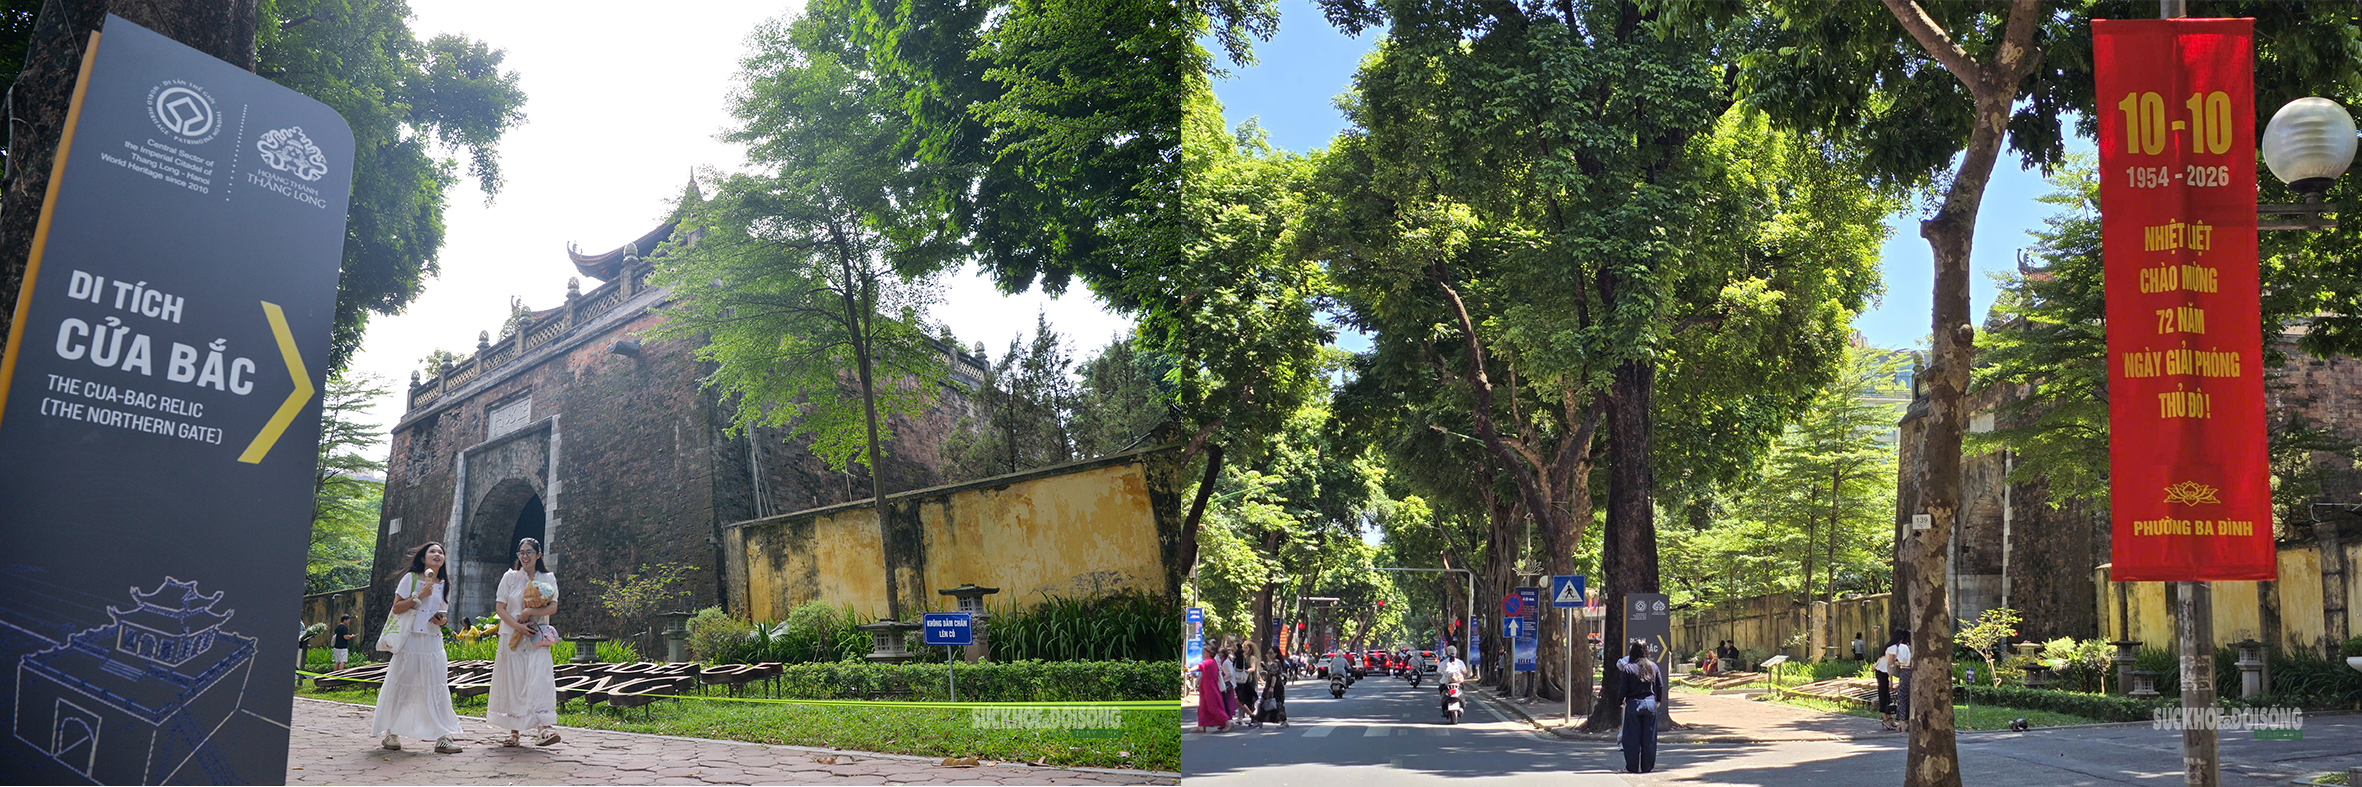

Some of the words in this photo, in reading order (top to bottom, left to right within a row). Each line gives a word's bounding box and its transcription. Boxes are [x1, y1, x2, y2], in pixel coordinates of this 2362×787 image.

[124, 141, 139, 151] the
[140, 146, 173, 163] Imperial
[174, 158, 203, 173] Citadel
[147, 138, 177, 155] Central
[178, 149, 205, 164] Sector
[100, 152, 127, 167] World
[127, 161, 164, 180] Heritage
[164, 175, 187, 187] since
[187, 182, 209, 194] 2010
[131, 152, 158, 168] Thang
[159, 162, 180, 176] Long
[186, 171, 210, 185] Hanoi
[2126, 166, 2169, 189] 1954
[2186, 164, 2229, 187] 2026
[247, 172, 292, 197] THĂNG
[293, 190, 327, 209] LONG
[2144, 218, 2185, 255] NHIỆT
[2187, 219, 2212, 256] LIỆT
[2140, 261, 2178, 294] CHÀO
[2181, 260, 2218, 293] MỪNG
[67, 269, 104, 304] DI
[112, 280, 185, 324] TÍCH
[2156, 308, 2174, 334] 72
[2177, 302, 2205, 334] NĂM
[55, 316, 152, 377] CỬA
[167, 338, 256, 396] BẮC
[2123, 346, 2162, 378] NGÀY
[2166, 340, 2193, 376] GIẢI
[2195, 346, 2240, 378] PHÓNG
[47, 373, 82, 395] THE
[83, 381, 157, 410] CUA-BAC
[159, 396, 204, 418] RELIC
[2158, 382, 2186, 418] THỦ
[2187, 387, 2204, 418] ĐÔ
[40, 397, 85, 421] (THE
[86, 406, 175, 437] NORTHERN
[178, 422, 223, 445] GATE)
[1916, 516, 1928, 524] 139
[2133, 515, 2191, 536] PHƯỜNG
[2195, 520, 2214, 536] BA
[2217, 517, 2253, 536] ĐÌNH
[926, 619, 942, 627] KHÔNG
[954, 618, 968, 627] CHÂN
[939, 629, 948, 638] LÊN
